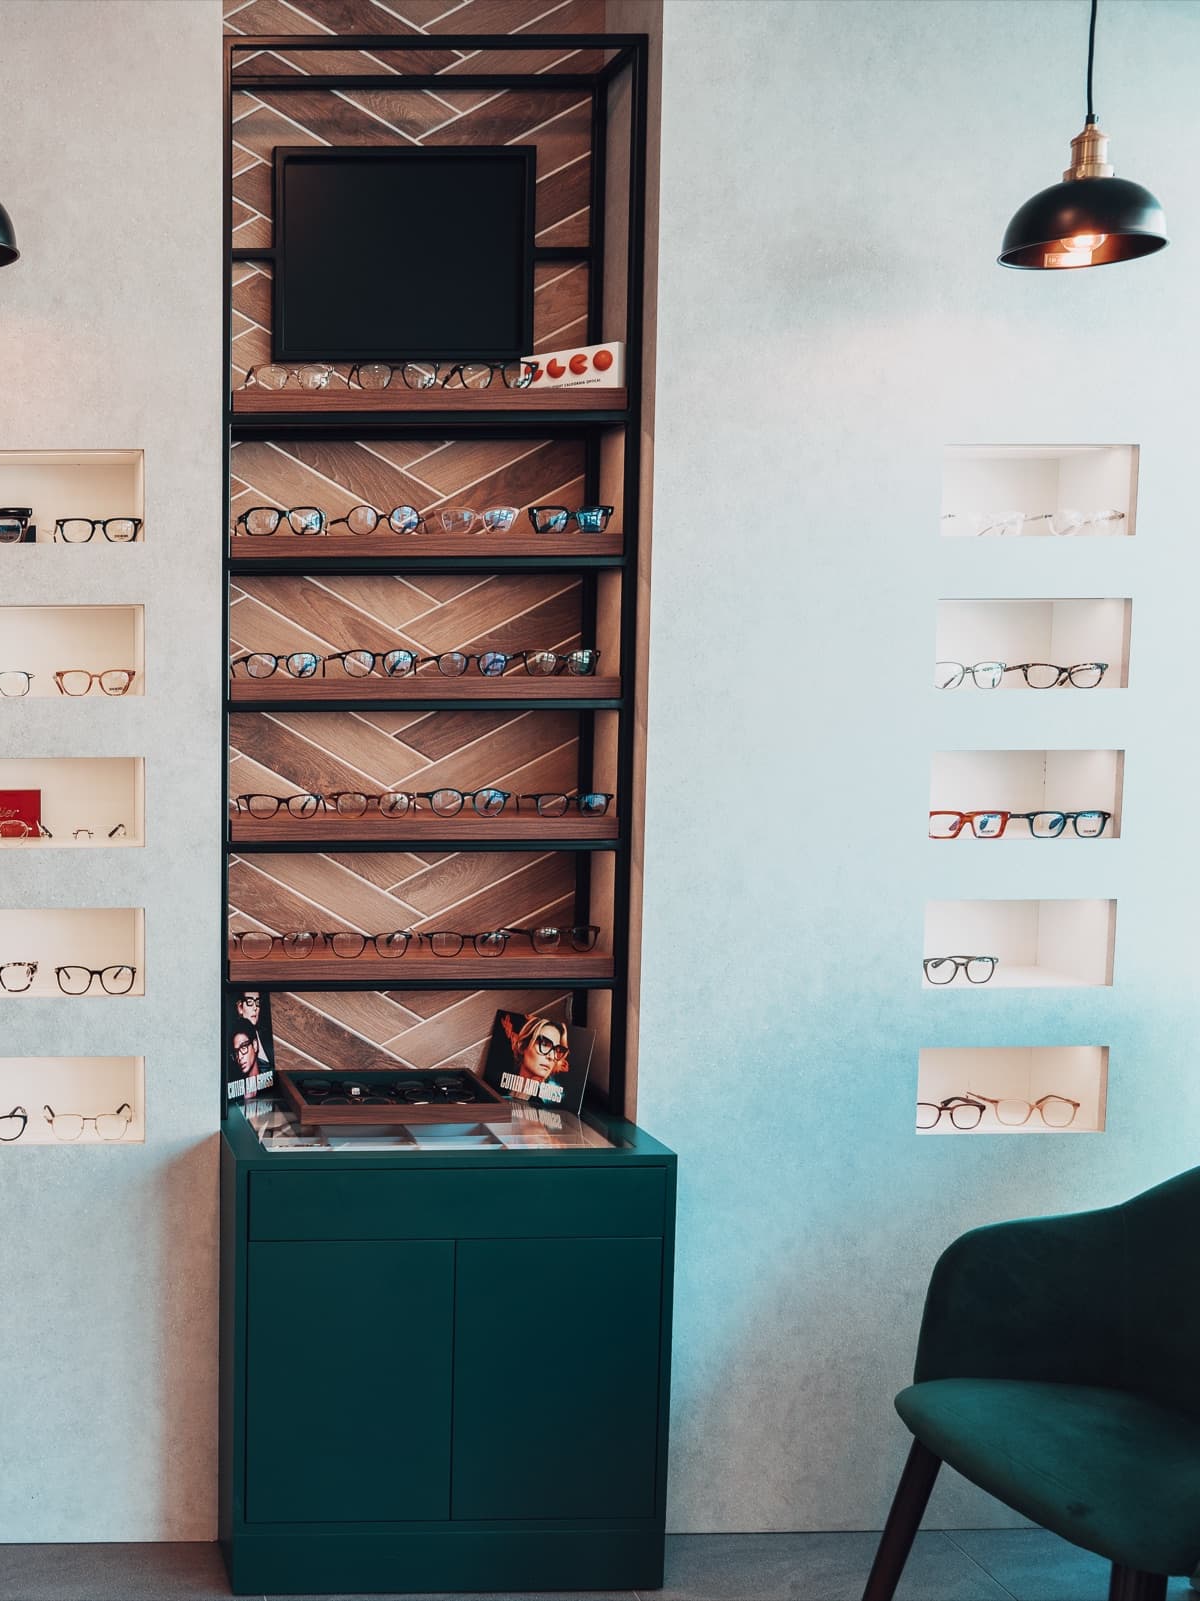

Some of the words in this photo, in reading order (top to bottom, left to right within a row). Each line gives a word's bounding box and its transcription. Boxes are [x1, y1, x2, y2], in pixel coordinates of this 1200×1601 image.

[500, 1072, 524, 1093] CUTLER
[523, 1078, 540, 1097] AND
[538, 1082, 564, 1103] GROSS
